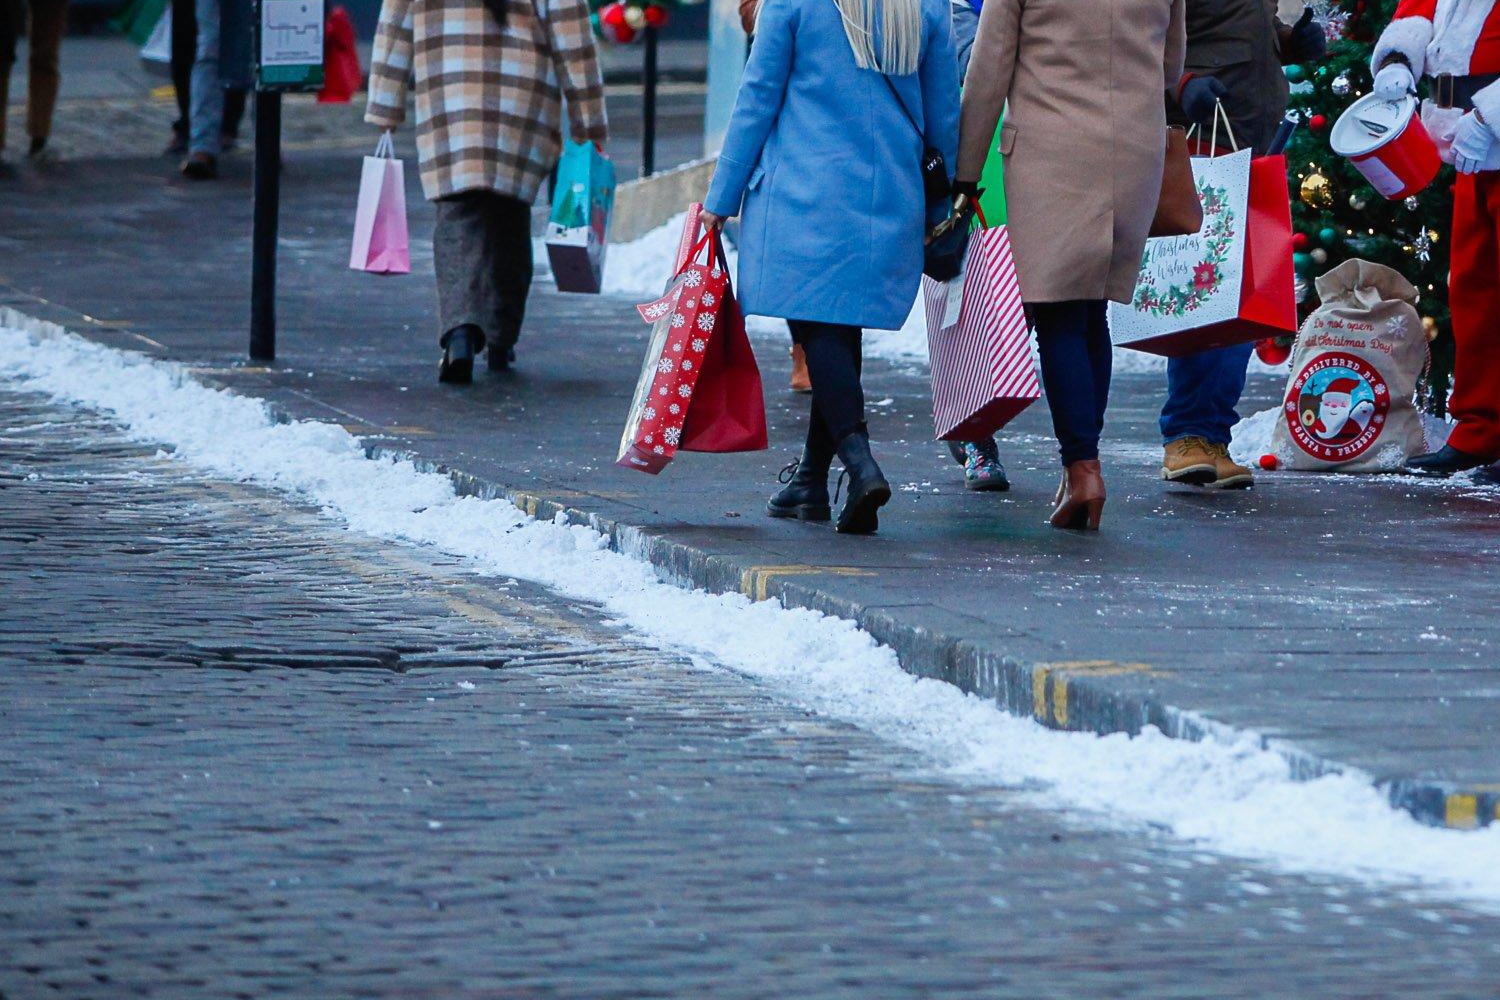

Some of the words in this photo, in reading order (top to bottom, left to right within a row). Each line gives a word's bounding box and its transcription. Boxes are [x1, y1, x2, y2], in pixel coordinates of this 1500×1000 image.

[1327, 318, 1345, 330] not
[1346, 321, 1375, 333] open
[1317, 331, 1366, 348] Christmas
[1303, 358, 1361, 379] DELIVERED
[1363, 371, 1377, 384] BY
[1294, 426, 1320, 453] SANTA
[1324, 447, 1332, 456] &
[1337, 425, 1377, 457] FRIENDS
